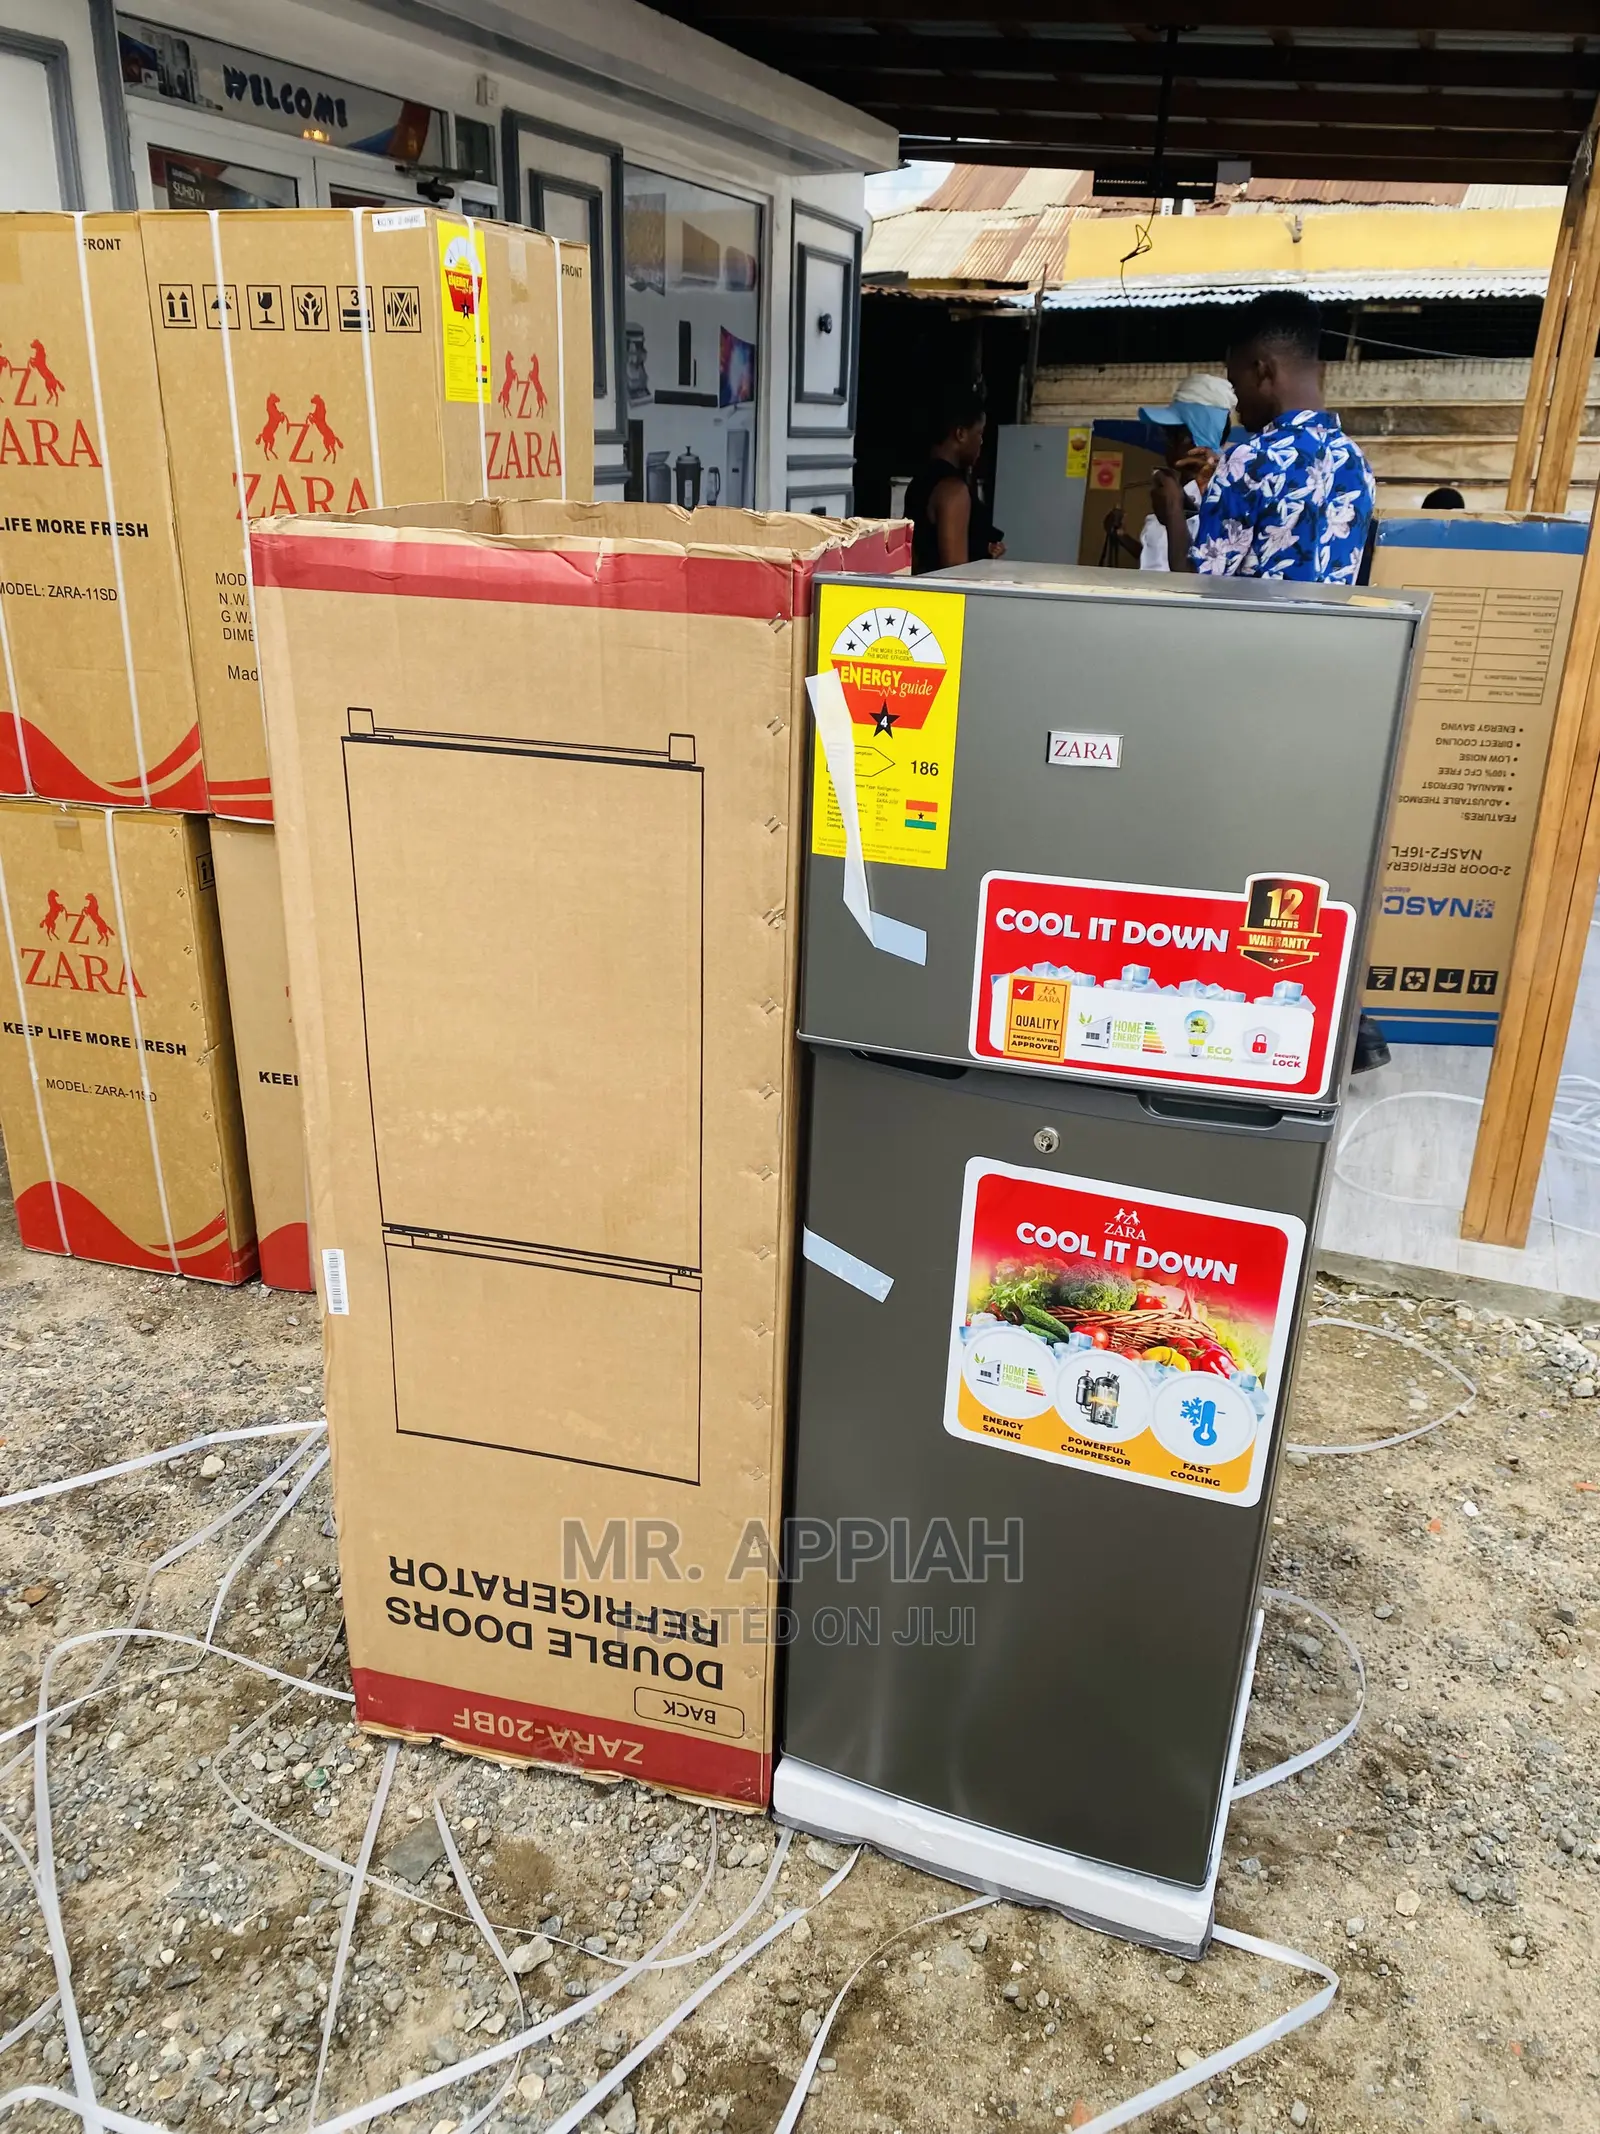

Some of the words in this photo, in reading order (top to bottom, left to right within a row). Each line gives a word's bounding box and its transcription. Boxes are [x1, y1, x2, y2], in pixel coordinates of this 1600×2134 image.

[222, 64, 348, 128] WELCOME
[561, 263, 583, 279] FRONT
[350, 289, 360, 307] 3
[10, 367, 38, 407] Z
[516, 380, 532, 419] Z
[286, 422, 314, 463] Z
[485, 430, 562, 480] ZARA
[232, 472, 370, 520] ZARA
[36, 518, 87, 535] MORE
[90, 521, 149, 538] FRESH
[215, 572, 247, 586] MOD
[47, 584, 118, 601] ZARA-11SD
[227, 664, 259, 682] Mad
[841, 662, 902, 691] ENERGY
[899, 680, 933, 697] guide
[880, 715, 888, 728] 4
[1441, 722, 1475, 731] SAVING
[1477, 724, 1516, 734] ENERGY
[1435, 737, 1477, 746] COOLING
[1479, 739, 1513, 748] DIRECT
[1054, 740, 1113, 761] ZARA
[1459, 753, 1487, 762] NOISE
[1489, 754, 1511, 763] LOW
[910, 760, 939, 776] 186
[1438, 766, 1462, 776] FREE
[1464, 768, 1482, 777] CFC
[1422, 781, 1464, 790] DEFROST
[1466, 783, 1505, 793] MANUAL
[1443, 796, 1503, 807] ADJUSTABLE
[1460, 812, 1517, 823] FEATURES:
[1391, 846, 1482, 860] NASF2-16FL
[1460, 864, 1512, 876] 2-DOOR
[1267, 888, 1304, 921] 12
[66, 913, 90, 945] Z
[996, 907, 1081, 939] COOL
[1088, 916, 1117, 942] IT
[1122, 920, 1229, 953] DOWN
[1263, 918, 1299, 929] MONTHS
[1248, 933, 1310, 950] WARRANTY
[20, 947, 148, 998] ZARA
[1375, 975, 1387, 989] 2
[1037, 994, 1061, 1004] ZARA
[1016, 1014, 1060, 1031] QUALITY
[1113, 1020, 1143, 1034] HOME
[3, 1022, 44, 1037] KEEP
[48, 1027, 83, 1042] LIFE
[86, 1032, 131, 1049] MORE
[1012, 1034, 1036, 1042] ENERGY
[1036, 1036, 1058, 1044] RATING
[1112, 1032, 1141, 1043] ENERGY
[1011, 1040, 1059, 1052] APPROVED
[1207, 1045, 1232, 1055] ECO
[1274, 1052, 1300, 1060] Security
[1272, 1060, 1302, 1069] LOCK
[45, 1078, 93, 1095] MODEL:
[1103, 1222, 1147, 1242] ZARA
[1016, 1222, 1097, 1259] COOL
[1103, 1239, 1131, 1264] IT
[1136, 1245, 1238, 1285] DOWN
[1003, 1363, 1027, 1378] HOME
[982, 1414, 1024, 1431] ENERGY
[982, 1424, 1022, 1440] SAVING
[1068, 1436, 1126, 1456] POWERFUL
[1060, 1444, 1131, 1467] COMPRESSOR
[1183, 1462, 1211, 1475] FAST
[1170, 1470, 1221, 1487] COOLING
[388, 1555, 718, 1648] REFRIGERATOR
[385, 1596, 533, 1650] DOORS
[547, 1627, 723, 1690] DOUBLE
[663, 1700, 716, 1725] BACK
[453, 1707, 645, 1765] ZARA-20BF
